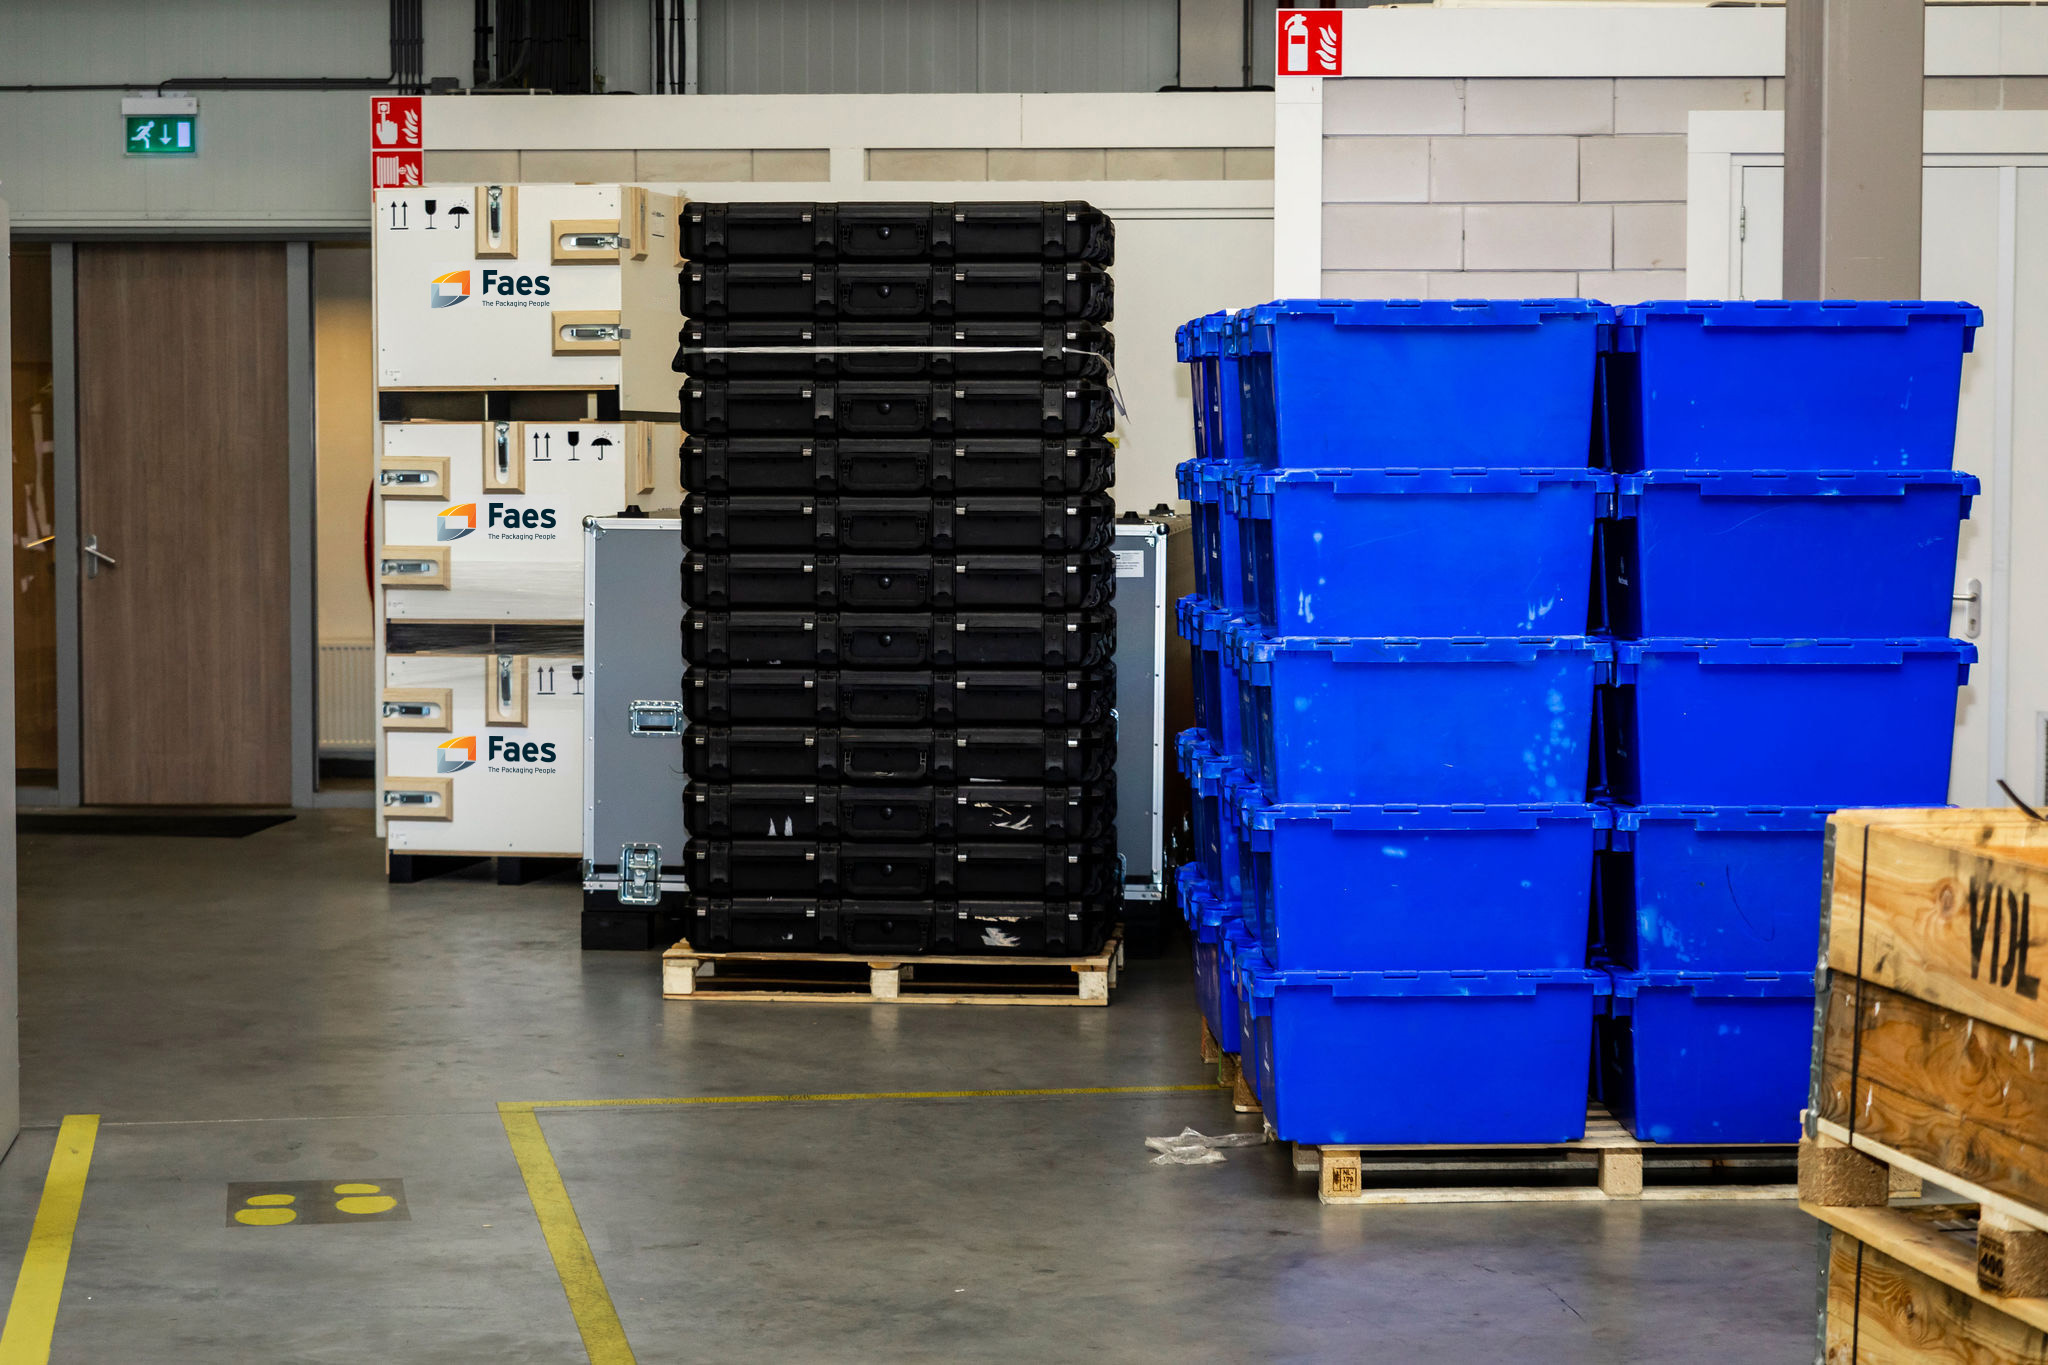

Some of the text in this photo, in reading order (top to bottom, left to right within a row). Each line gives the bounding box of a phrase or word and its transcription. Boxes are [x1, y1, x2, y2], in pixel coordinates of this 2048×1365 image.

[483, 270, 550, 295] Faes
[489, 503, 556, 528] Faes
[489, 736, 556, 762] Faes
[502, 766, 534, 775] Packaging
[535, 767, 557, 775] People
